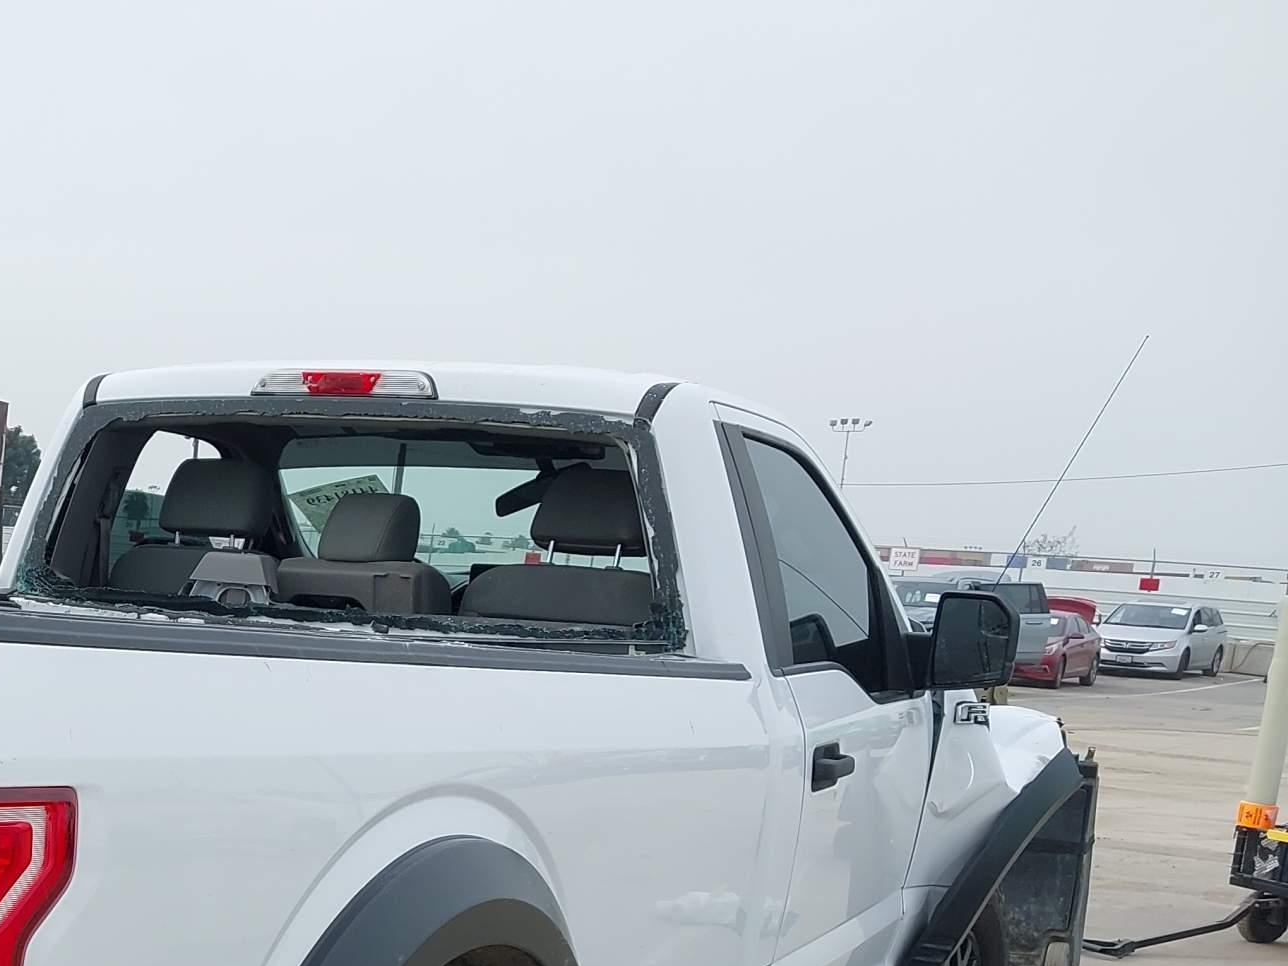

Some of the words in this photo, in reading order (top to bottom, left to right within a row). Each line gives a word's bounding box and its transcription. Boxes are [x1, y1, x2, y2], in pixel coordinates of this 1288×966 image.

[894, 551, 917, 559] STATE
[1031, 559, 1042, 567] 26
[1209, 571, 1221, 579] 27
